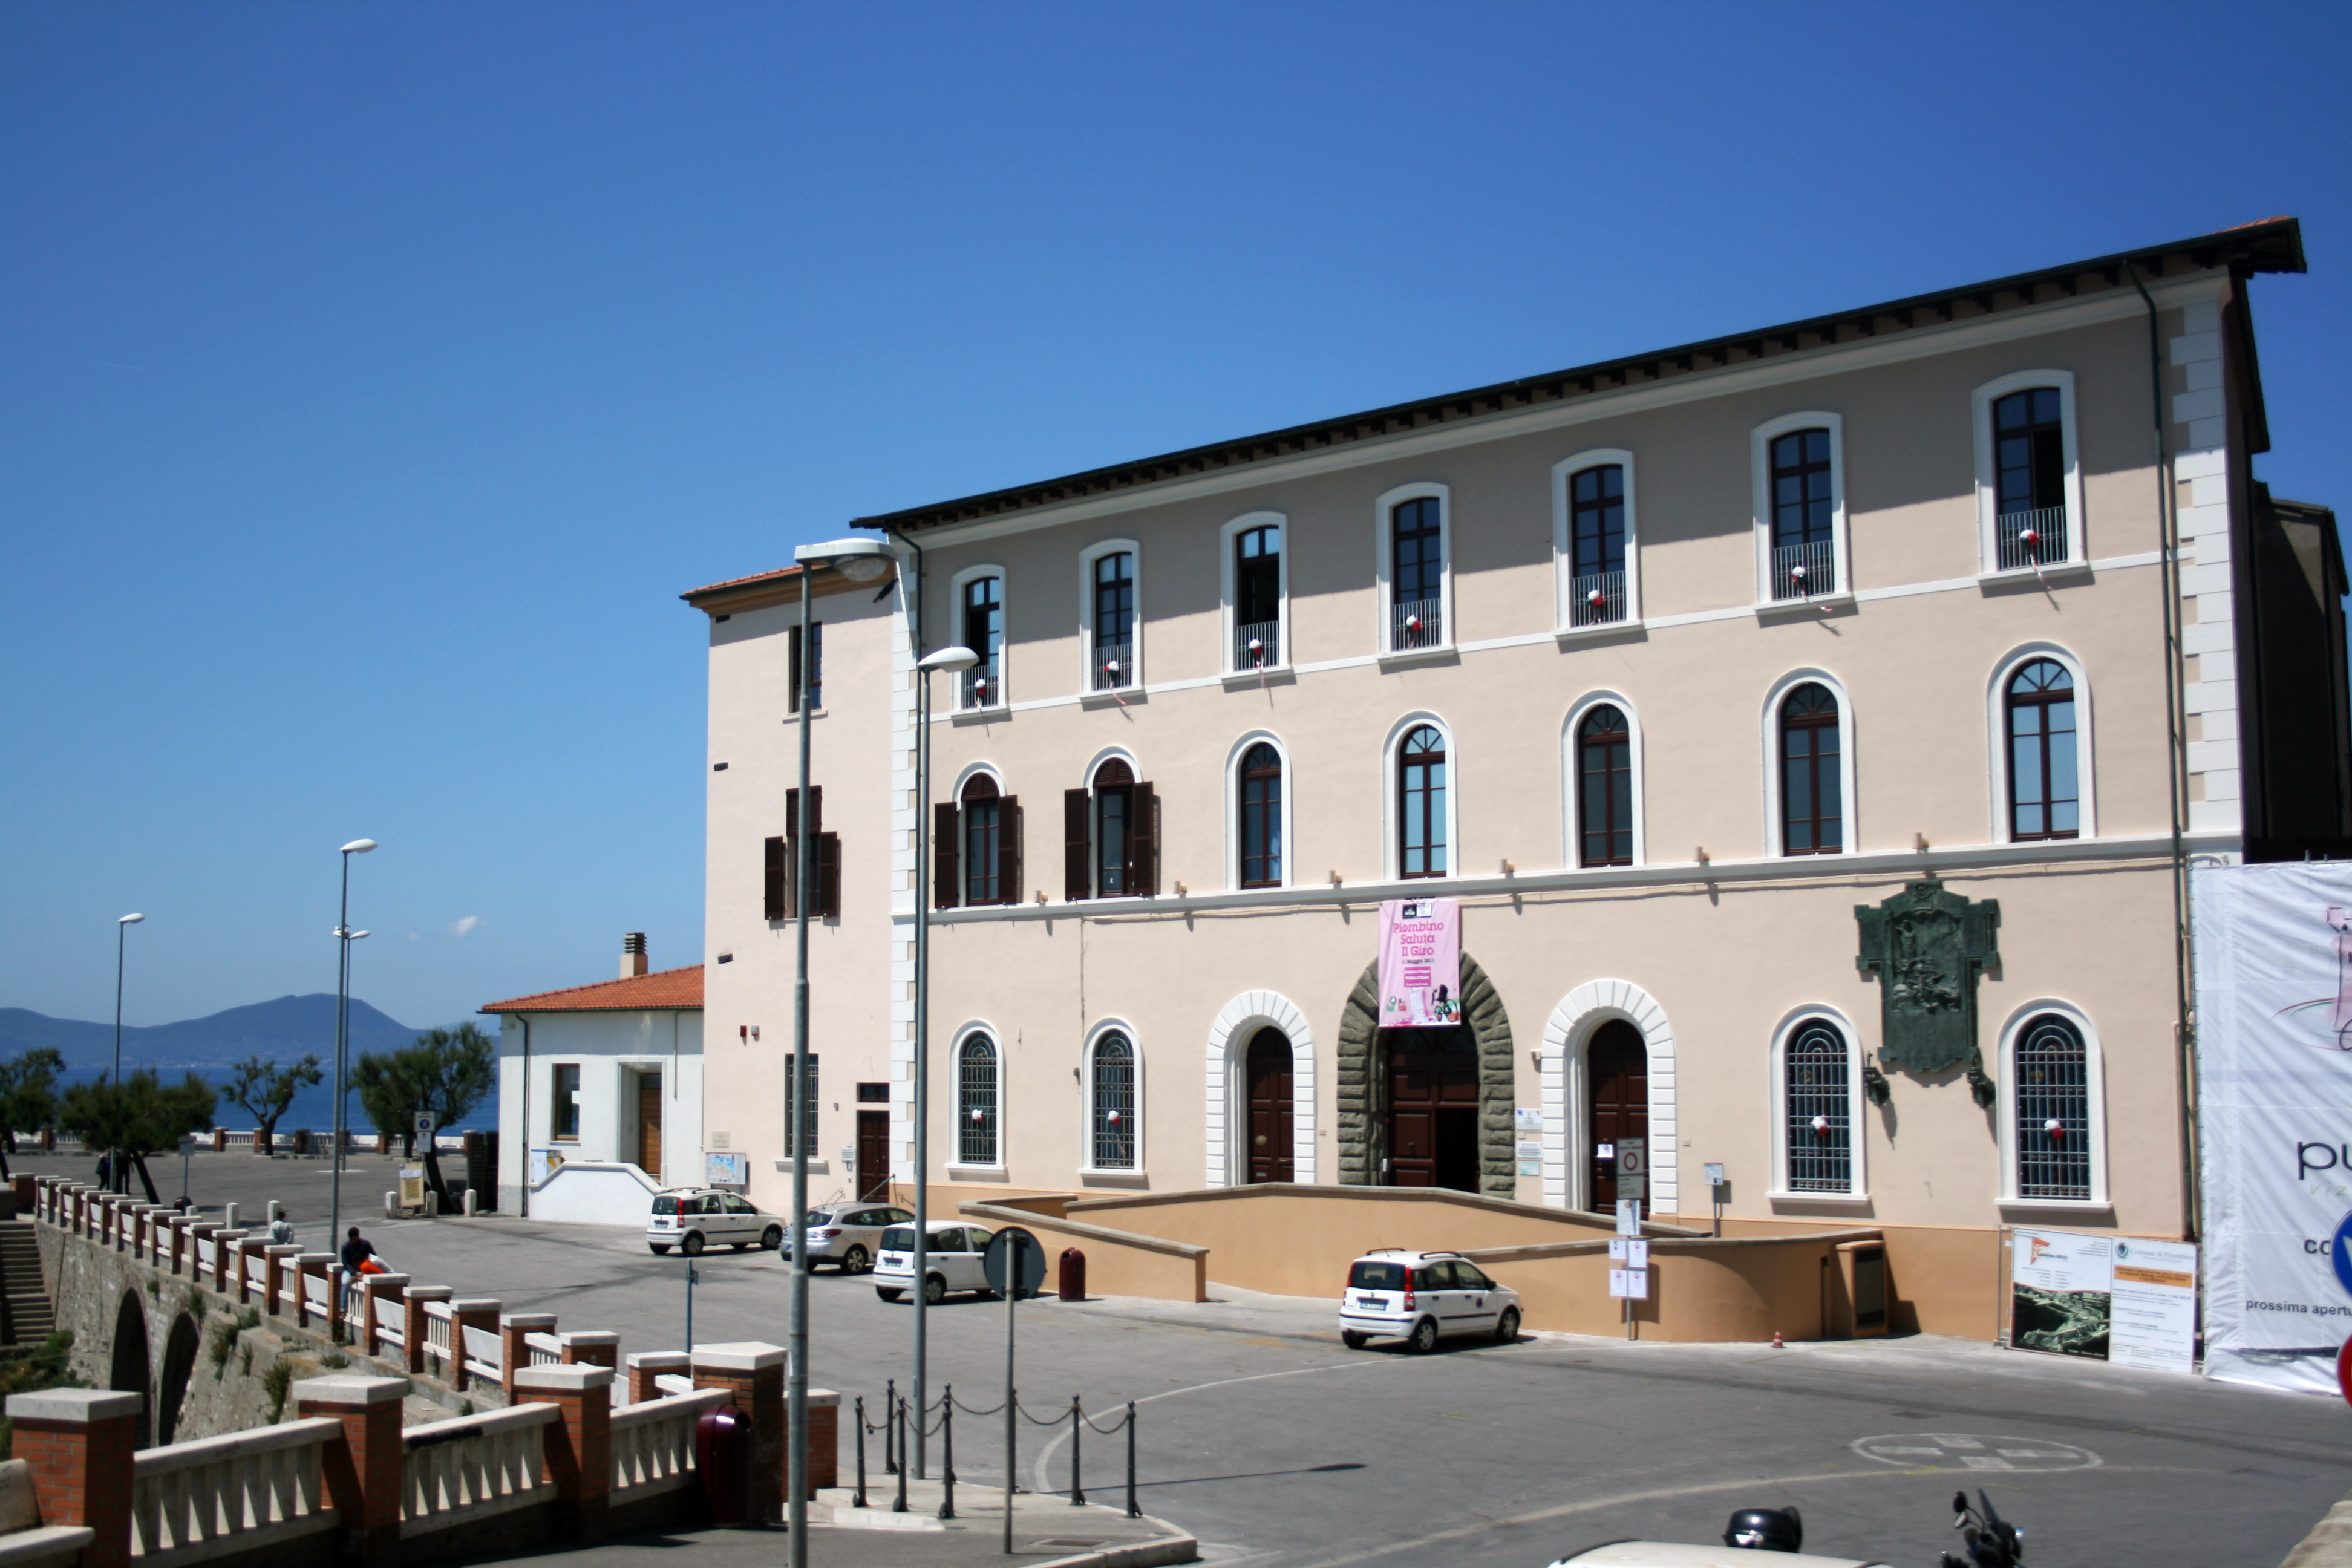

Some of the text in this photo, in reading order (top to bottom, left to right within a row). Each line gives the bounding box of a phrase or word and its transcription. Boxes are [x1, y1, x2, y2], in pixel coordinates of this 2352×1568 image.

[1393, 921, 1444, 933] Piombino
[1400, 933, 1436, 944] Saluta
[1402, 946, 1434, 956] Il Giro
[2246, 1300, 2307, 1314] prossima
